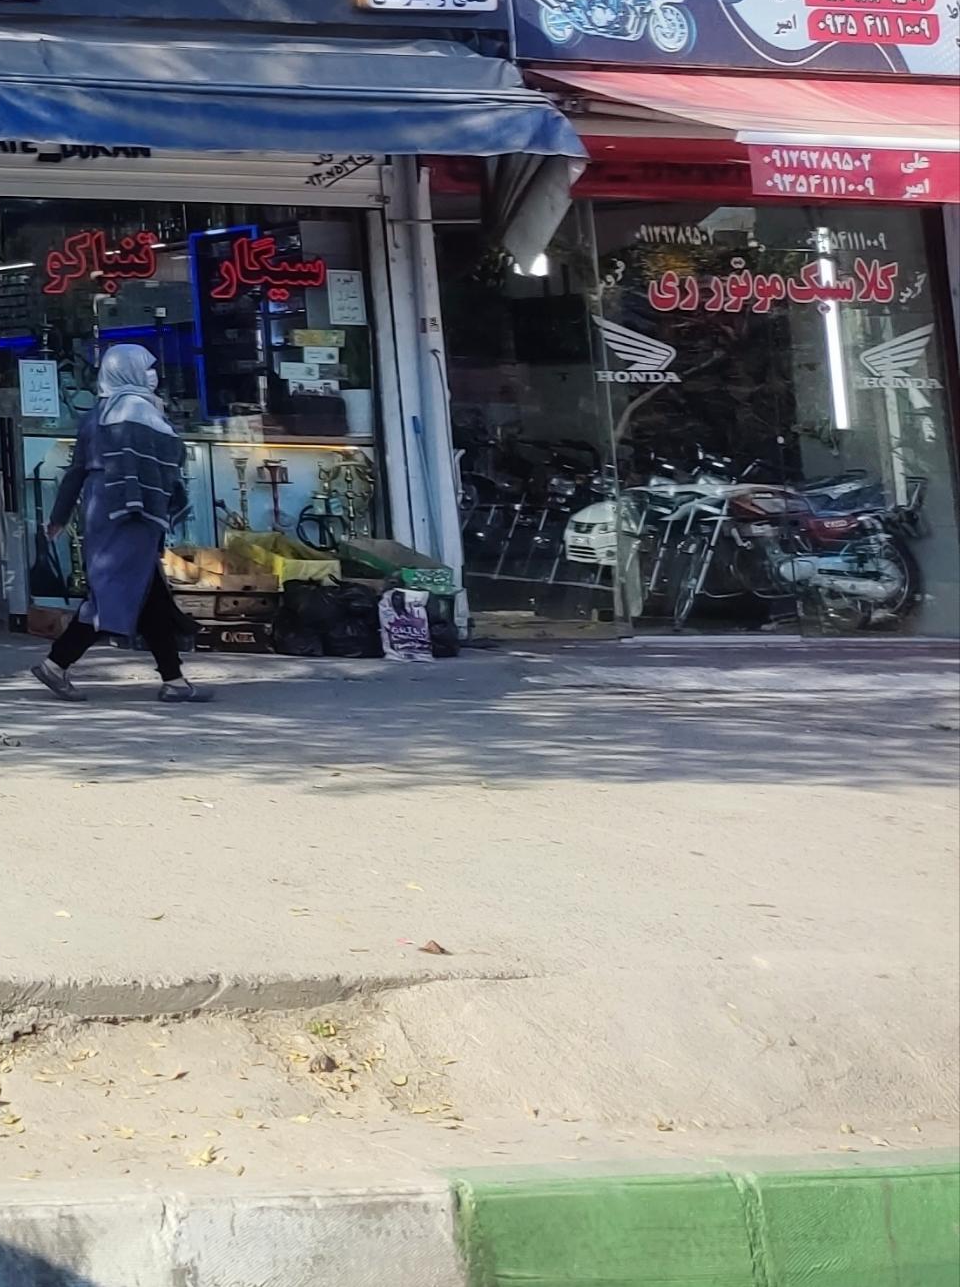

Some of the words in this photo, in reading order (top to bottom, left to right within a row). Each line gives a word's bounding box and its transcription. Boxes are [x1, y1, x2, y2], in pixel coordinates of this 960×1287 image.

[774, 14, 798, 35] امیر
[818, 13, 858, 36] ۰۹۳۵
[863, 15, 890, 37] ۴۱۱
[896, 16, 932, 39] ۱۰۰۹
[900, 152, 931, 174] علی
[902, 177, 930, 199] امیر
[42, 230, 159, 294] تنباکو
[210, 237, 327, 301] سیگار
[648, 270, 700, 311] ری
[704, 256, 785, 313] موتور
[787, 257, 899, 314] کلاسیک
[594, 370, 683, 383] HONDA
[860, 377, 945, 389] HONDA
